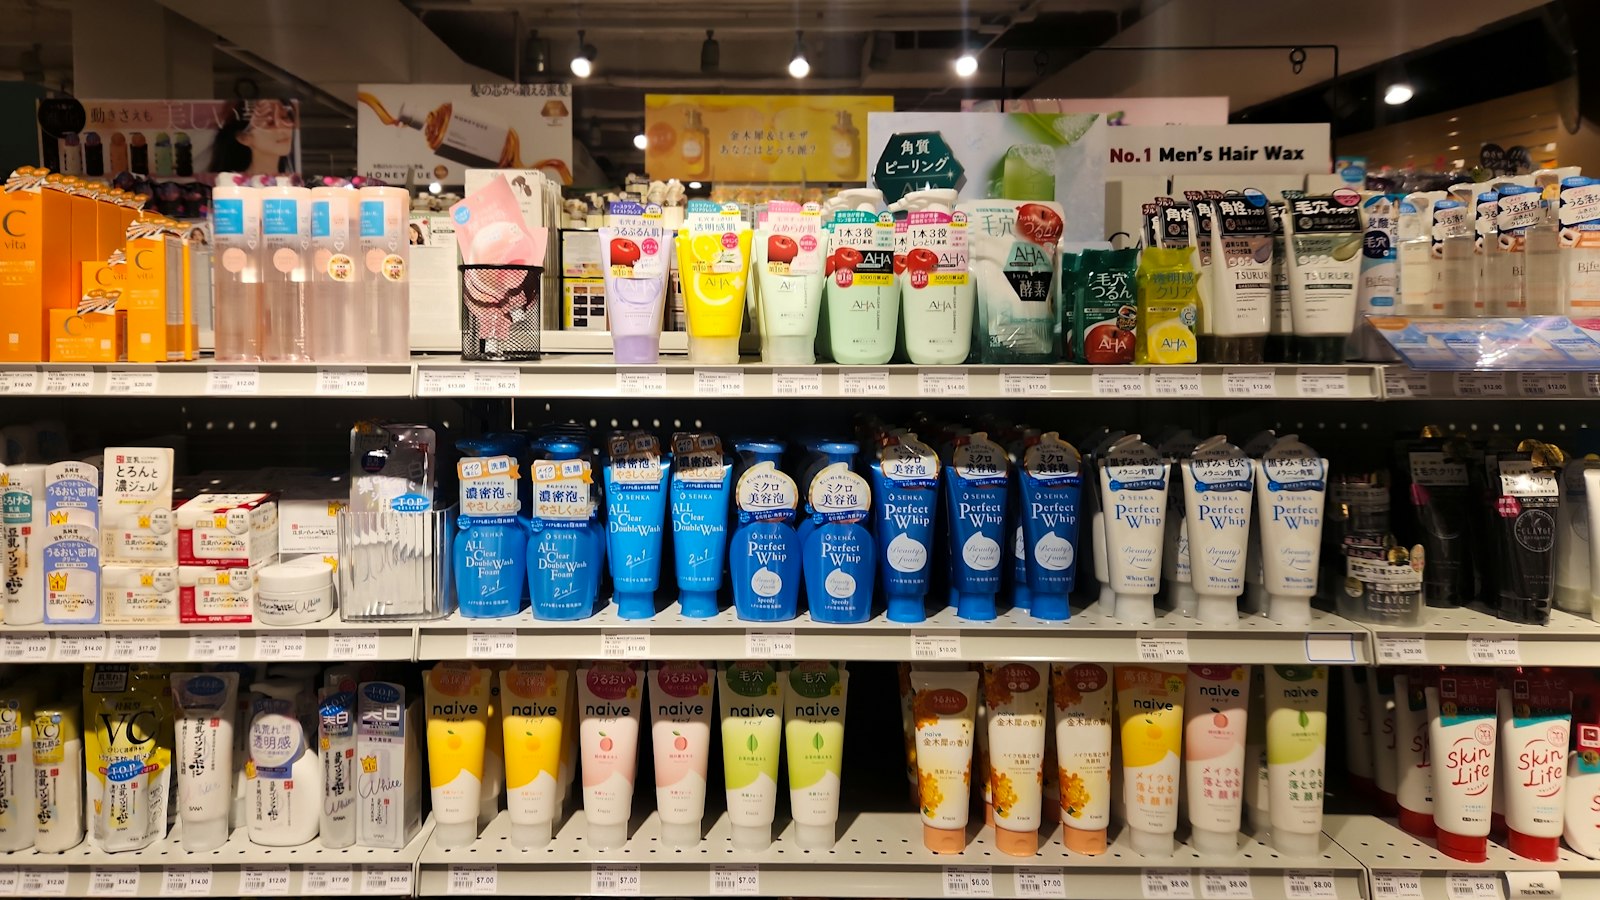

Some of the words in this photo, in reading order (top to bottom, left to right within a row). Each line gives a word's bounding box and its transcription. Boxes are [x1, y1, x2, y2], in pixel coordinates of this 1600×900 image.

[90, 106, 153, 123] 動きさえも
[900, 139, 930, 156] 角質
[1109, 147, 1151, 163] No.1
[1159, 146, 1213, 162] Men's
[1218, 146, 1259, 162] Hair
[1264, 146, 1305, 161] Wax
[885, 155, 950, 175] ピーリング
[366, 171, 431, 180] HONEYUE
[2, 210, 27, 237] C
[694, 223, 737, 232] 透明感肌
[772, 224, 816, 234] なめらか肌
[981, 214, 1016, 238] 毛穴
[613, 227, 660, 238] うるぷるん肌
[912, 229, 947, 239] 1本3役
[4, 238, 27, 250] vita
[864, 252, 892, 268] AHA
[1154, 272, 1195, 285] 透明感
[1019, 280, 1046, 298] 酵素
[1091, 286, 1132, 300] つるん
[1156, 286, 1193, 299] クリア
[64, 316, 83, 336] C
[1098, 338, 1127, 353] AHA
[1161, 338, 1188, 352] AHA
[968, 454, 992, 464] ミクロ
[1040, 454, 1064, 464] ミクロ
[1110, 457, 1159, 467] 黒ずみ・毛穴
[1195, 458, 1245, 468] 黒ずみ・毛穴
[115, 465, 159, 479] とろんと
[463, 463, 480, 471] メイク
[491, 461, 507, 471] 洗顔
[893, 464, 927, 475] 美容泡
[965, 464, 998, 474] 美容泡
[1117, 468, 1155, 476] メラニン角質
[1201, 469, 1241, 477] メラニン角質
[1275, 469, 1315, 477] メラニン角質
[49, 486, 96, 497] うるおい密閉
[115, 479, 159, 493] 濃ジェル
[753, 482, 780, 493] ミクロ
[826, 483, 853, 493] ミクロ
[465, 486, 512, 500] 濃密泡で
[539, 490, 585, 503] 濃密泡で
[748, 493, 784, 504] 美容泡
[822, 493, 858, 506] 美容泡
[608, 503, 630, 516] ALL
[671, 502, 693, 515] ALL
[884, 503, 929, 520] Perfect
[959, 502, 1001, 520] Perfect
[1031, 502, 1075, 520] Perfect
[617, 513, 642, 526] Clear
[680, 512, 705, 525] Clear
[893, 514, 930, 529] Whip
[968, 513, 1003, 528] Whip
[1040, 513, 1076, 528] Whip
[465, 540, 485, 552] ALL
[537, 541, 558, 553] ALL
[748, 540, 786, 557] Perfect
[821, 542, 860, 558] Perfect
[47, 547, 97, 558] うるおい密閉
[473, 550, 497, 561] Clear
[546, 552, 570, 563] Clear
[756, 551, 787, 565] Whip
[829, 552, 861, 567] Whip
[478, 567, 500, 579] Foam
[550, 569, 573, 581] Foam
[831, 598, 849, 606] Speedy
[1369, 594, 1411, 605] CLAYGE
[591, 673, 632, 685] うるおい
[663, 673, 703, 685] うるおい
[739, 670, 764, 682] 毛穴
[801, 671, 828, 684] 毛穴
[1460, 678, 1491, 689] ニキビ
[1531, 678, 1566, 689] ニキビ
[432, 701, 478, 715] naive
[511, 702, 557, 717] naive
[586, 702, 631, 716] naive
[658, 701, 704, 716] naive
[730, 703, 775, 718] naive
[795, 702, 840, 717] naive
[996, 717, 1043, 727] 金木犀の香り
[1066, 718, 1111, 727] 金木犀の香り
[99, 711, 157, 747] VC
[253, 725, 281, 735] 肌荒れ
[252, 736, 292, 750] 透明感
[923, 738, 970, 747] 金木犀の香り
[1446, 747, 1491, 769] Skin
[1517, 749, 1564, 771] Skin
[1135, 771, 1174, 783] メイクも
[1203, 767, 1240, 776] メイクも
[1451, 763, 1490, 786] Life
[1523, 765, 1563, 788] Life
[358, 772, 402, 800] White
[1135, 782, 1174, 794] 落とせる
[1203, 777, 1240, 787] 落とせる
[1136, 794, 1173, 807] 洗顔料
[1203, 789, 1240, 800] 洗顔料
[476, 876, 494, 884] $7.00
[738, 876, 757, 884] $7.00
[971, 878, 990, 886] $6.00
[1043, 879, 1062, 887] $7.00
[1170, 880, 1189, 888] $8.00
[1229, 880, 1248, 888] $8.00
[1313, 881, 1332, 889] $8.00
[1519, 889, 1555, 897] TREATMENT
